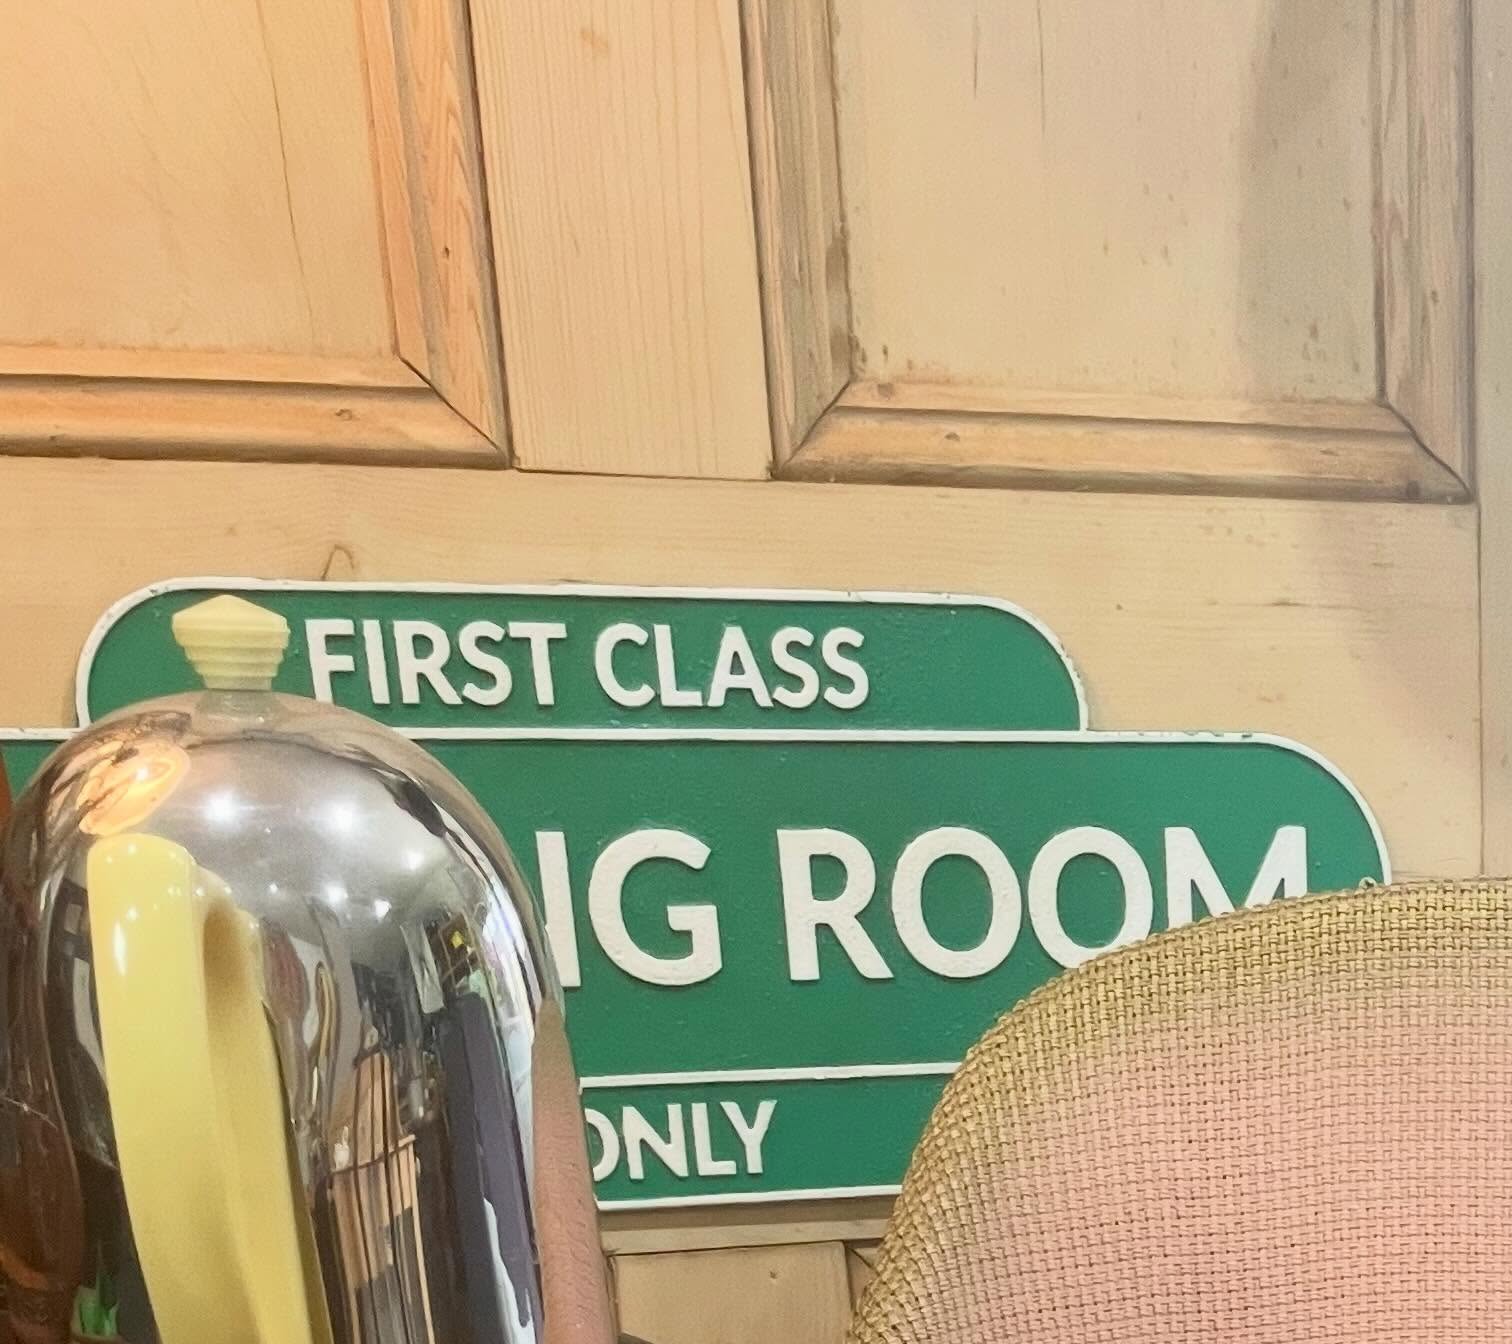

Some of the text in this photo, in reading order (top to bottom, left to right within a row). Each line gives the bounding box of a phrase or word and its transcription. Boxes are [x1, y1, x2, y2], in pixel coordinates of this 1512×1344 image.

[304, 618, 870, 709] FIRST CLASS
[776, 824, 1308, 980] ROOM
